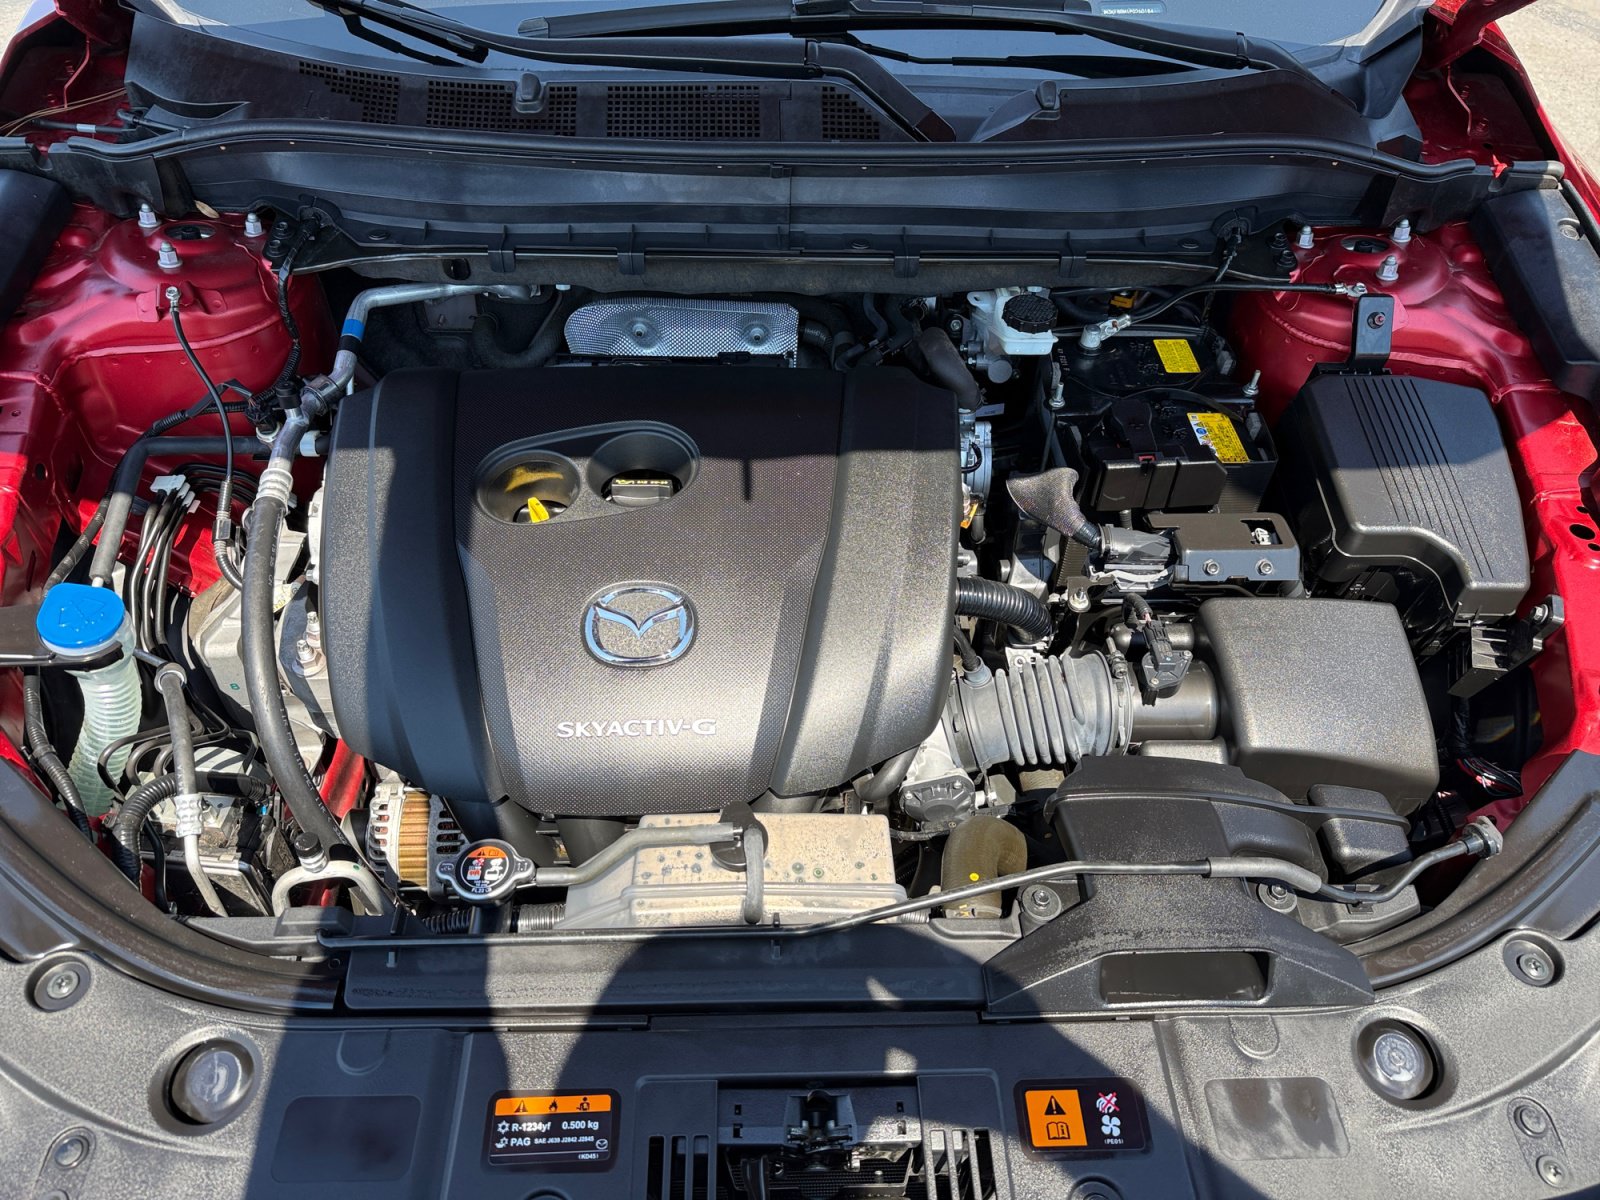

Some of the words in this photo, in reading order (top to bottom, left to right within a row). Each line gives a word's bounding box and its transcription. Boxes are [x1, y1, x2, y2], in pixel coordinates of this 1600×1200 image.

[557, 718, 717, 738] SKYACTIV-G
[511, 1122, 552, 1133] R-1234yf
[562, 1121, 586, 1130] 0.500
[587, 1120, 599, 1130] kg
[510, 1137, 531, 1146] PAG
[534, 1137, 547, 1145] SAE
